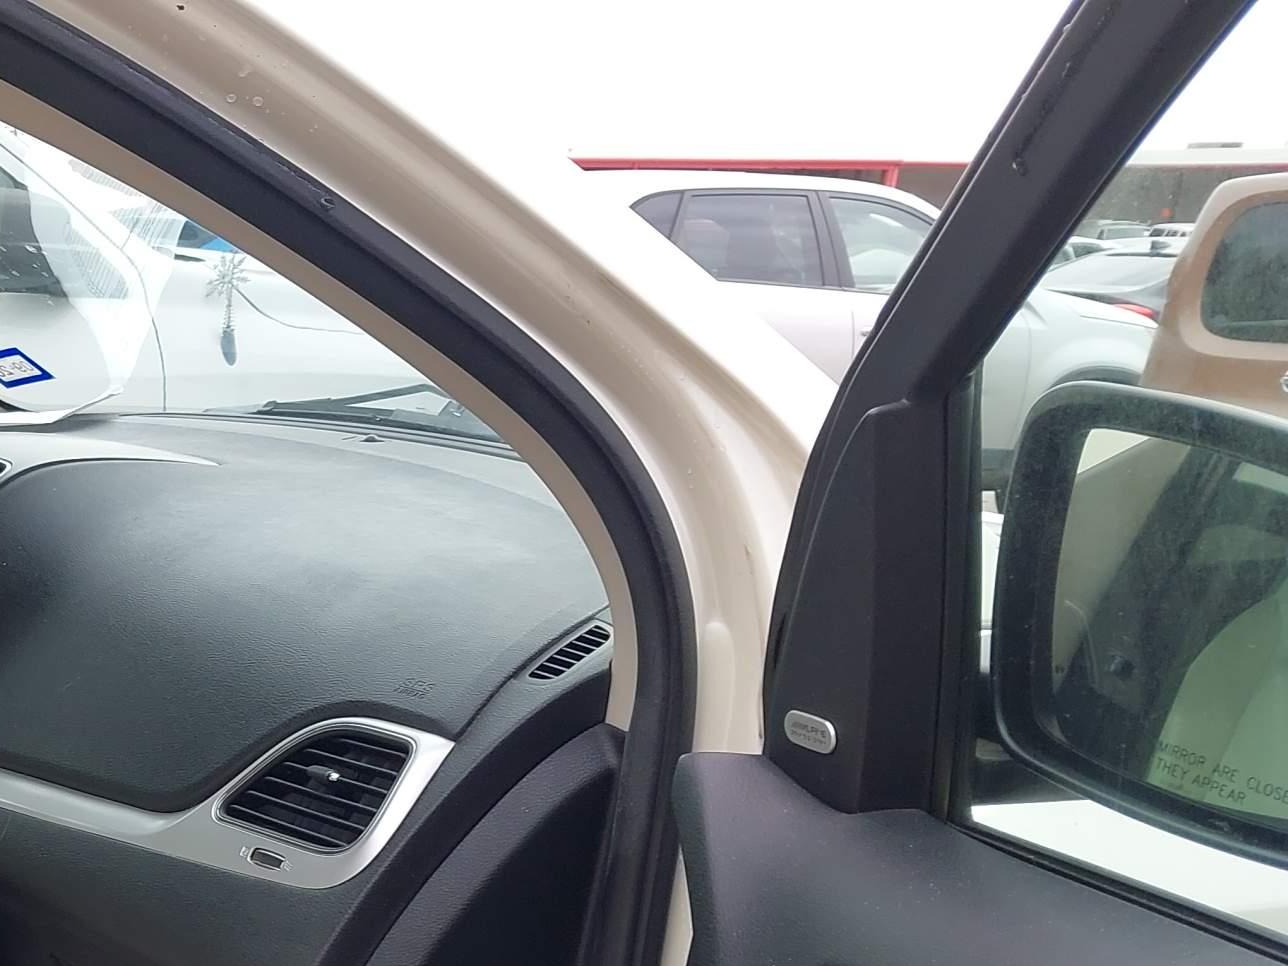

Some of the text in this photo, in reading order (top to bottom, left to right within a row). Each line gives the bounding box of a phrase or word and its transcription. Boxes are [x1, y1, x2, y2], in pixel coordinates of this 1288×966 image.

[1155, 757, 1246, 805] THEY APPEAR
[1211, 763, 1240, 784] ARE
